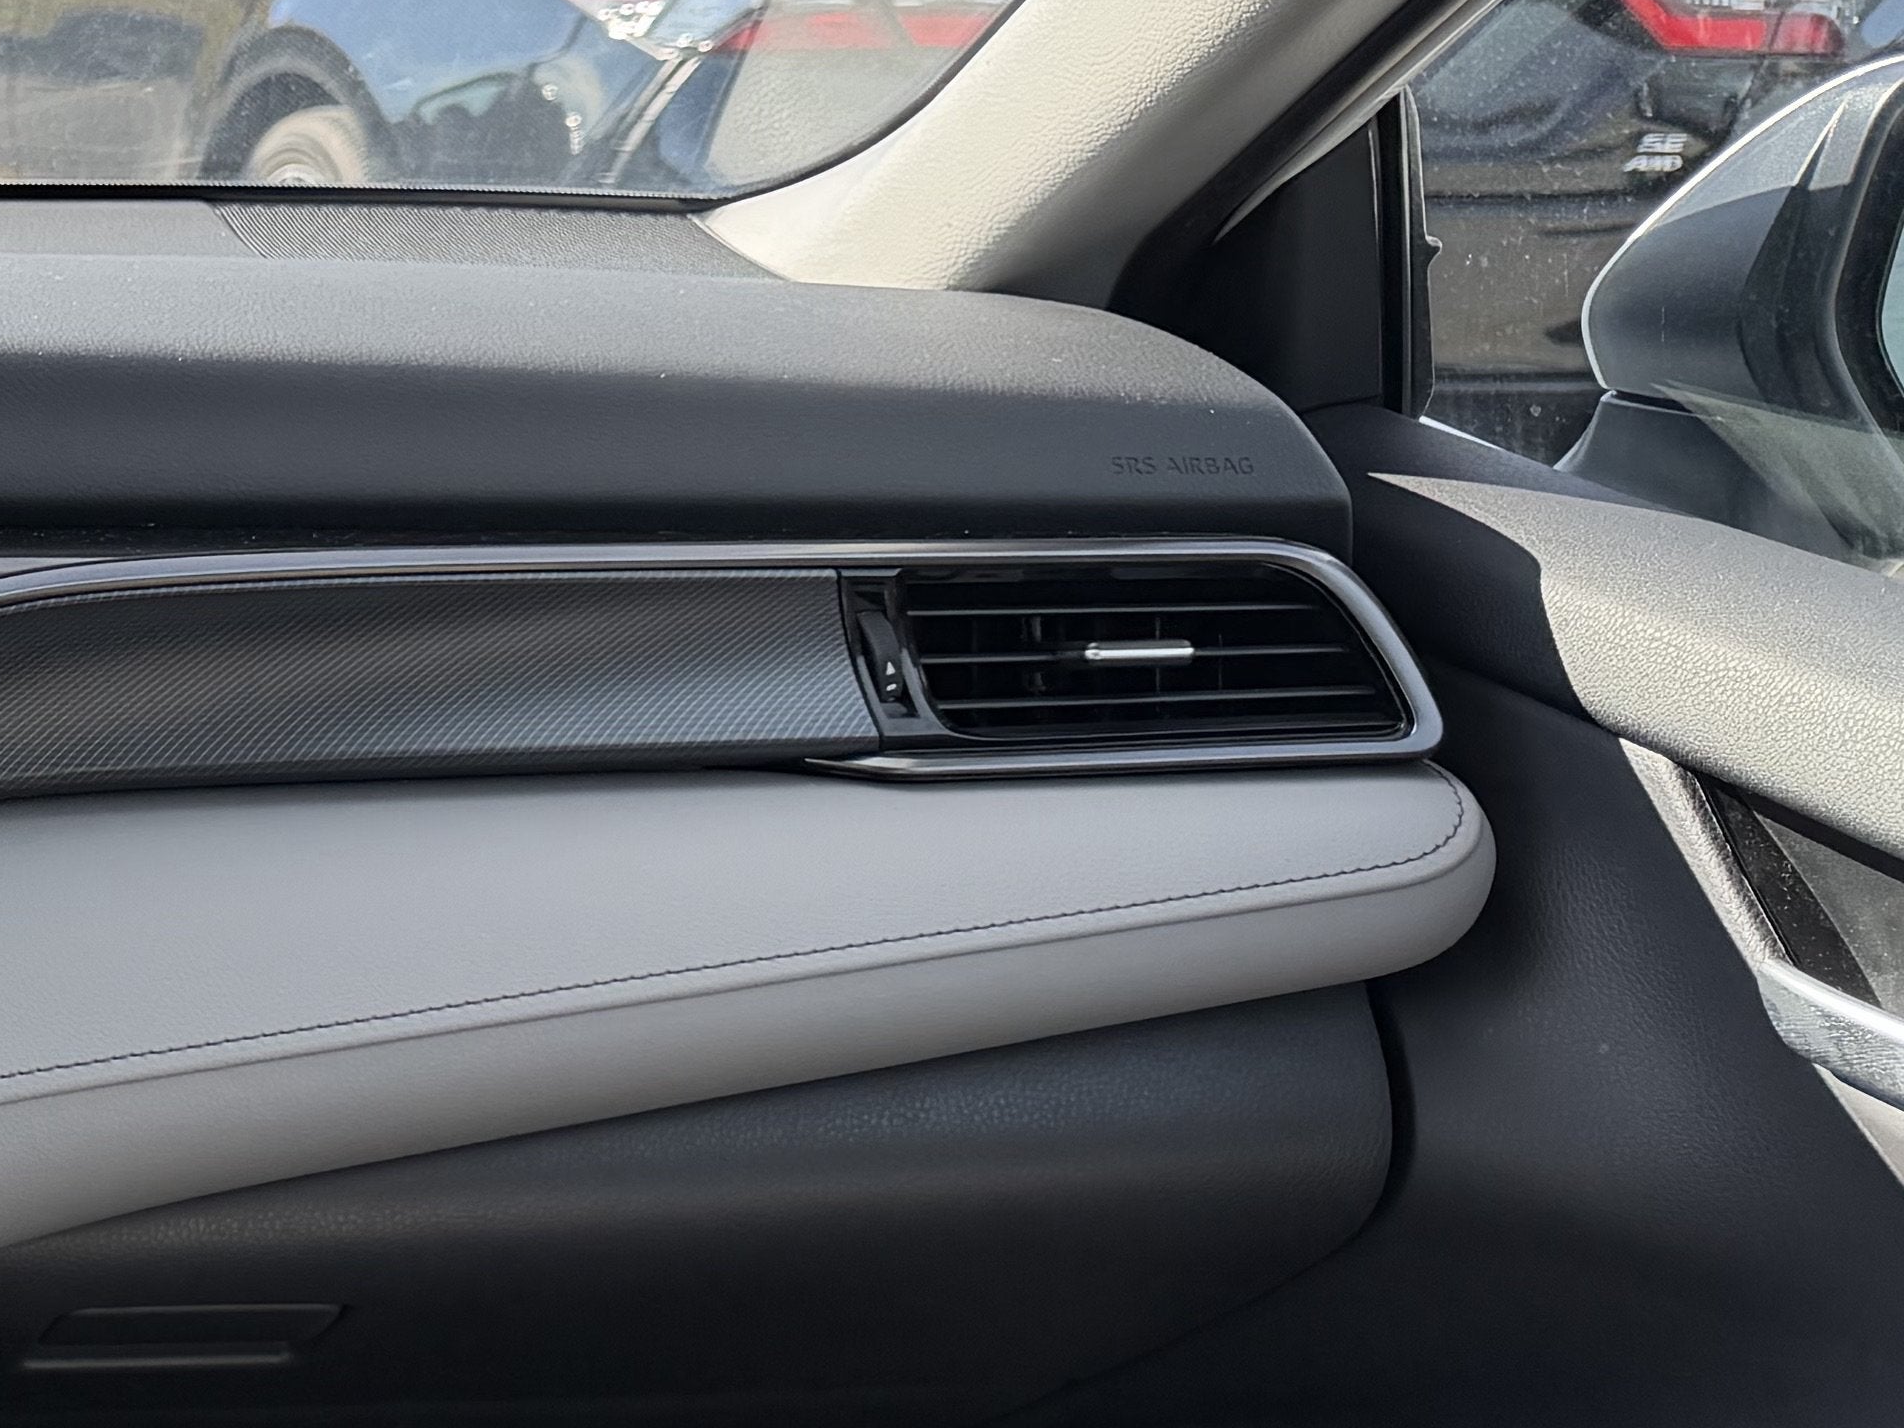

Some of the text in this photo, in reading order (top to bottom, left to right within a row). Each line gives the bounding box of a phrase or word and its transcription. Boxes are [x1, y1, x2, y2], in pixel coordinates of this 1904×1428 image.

[1637, 133, 1688, 152] SE
[1110, 456, 1256, 476] SRS AIRBAG
